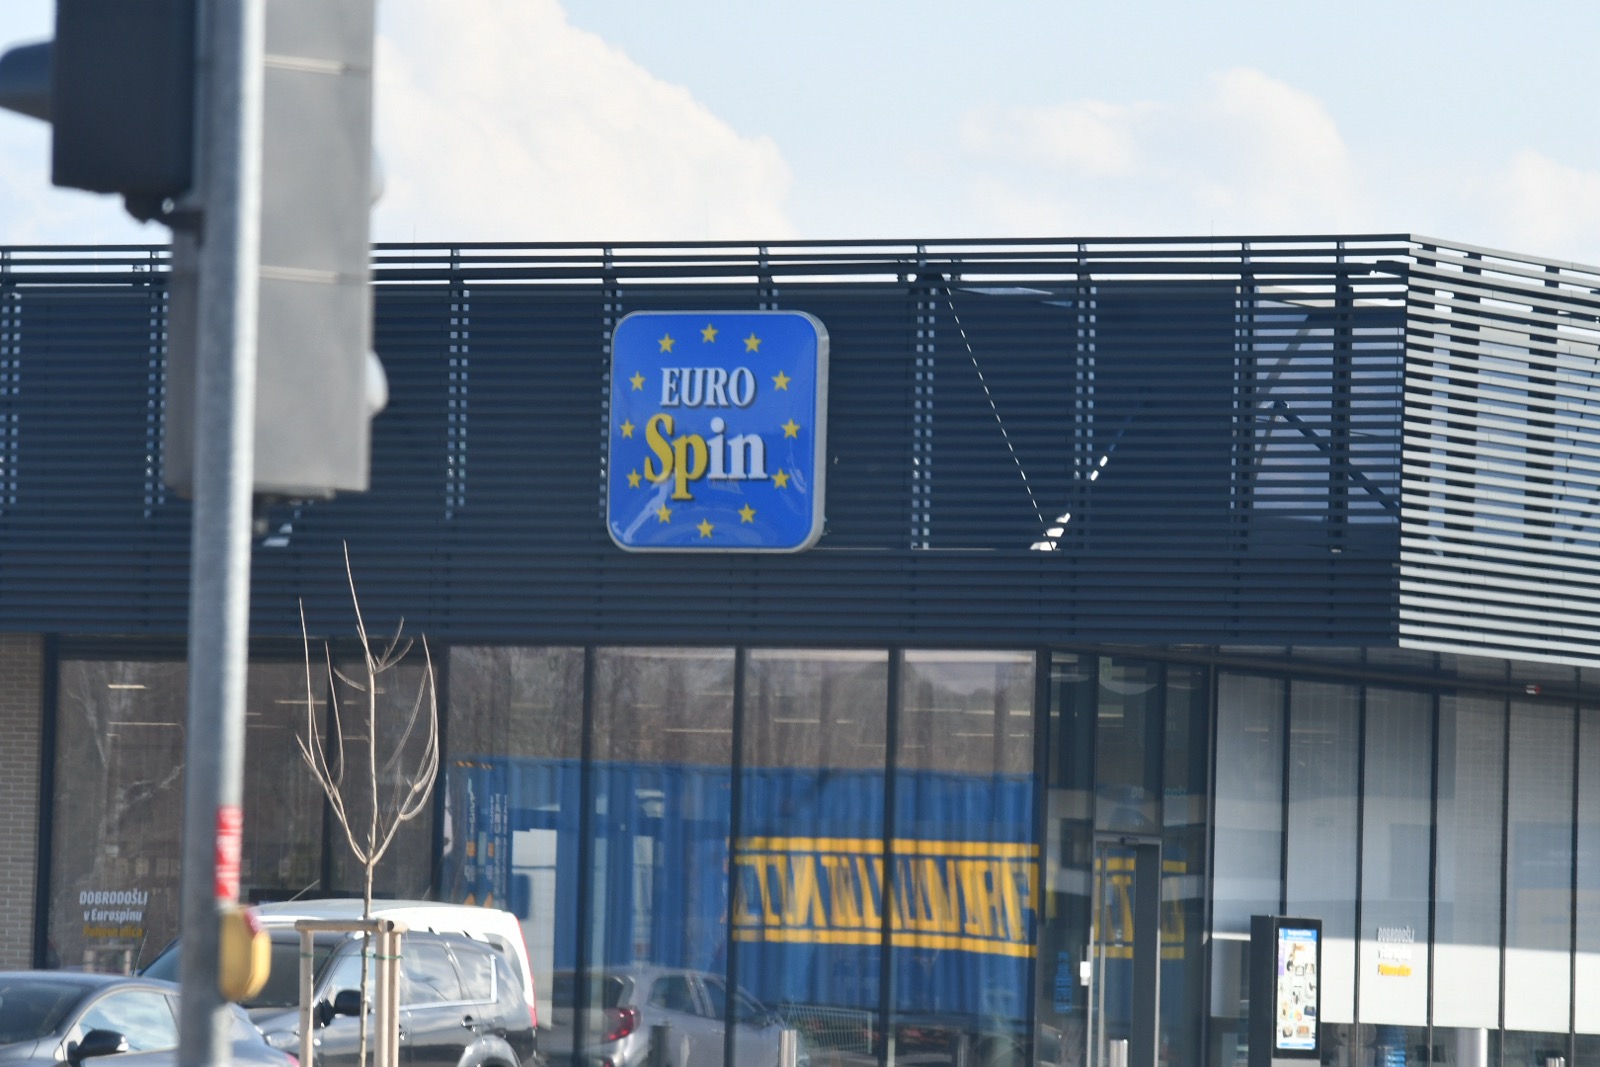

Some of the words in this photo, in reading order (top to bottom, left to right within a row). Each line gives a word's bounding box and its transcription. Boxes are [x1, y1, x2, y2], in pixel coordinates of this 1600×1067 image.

[659, 366, 756, 408] EURO
[644, 413, 769, 500] Spin
[79, 888, 148, 905] DOBRODOŠLI
[83, 910, 90, 921] v
[92, 908, 142, 924] Eurospinu
